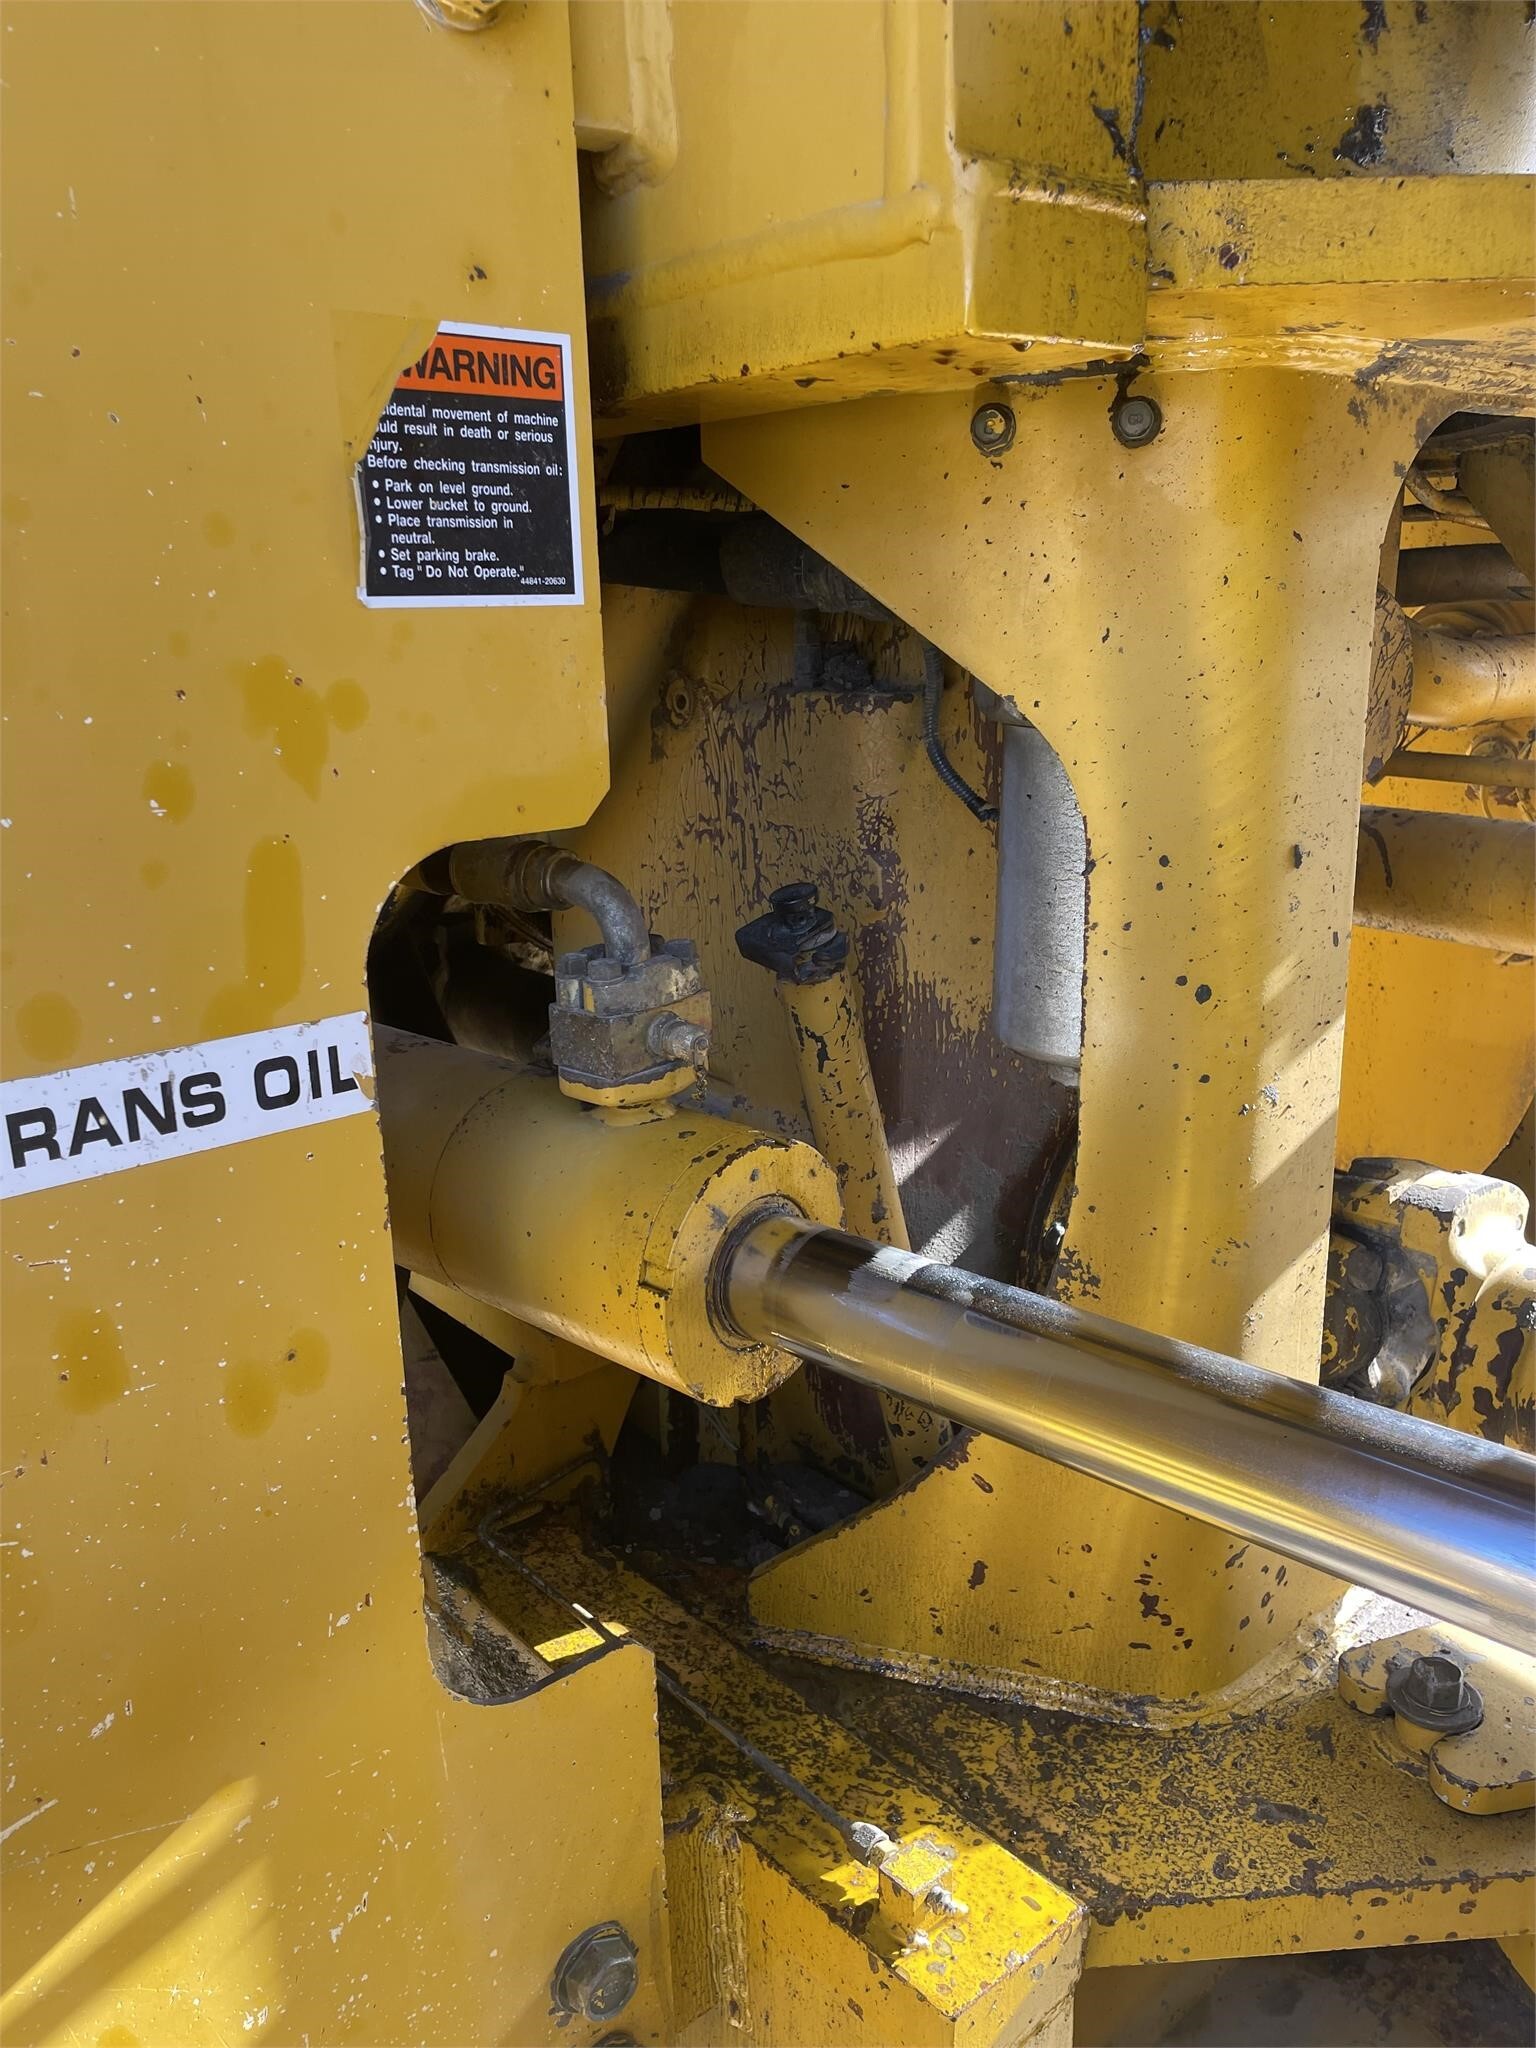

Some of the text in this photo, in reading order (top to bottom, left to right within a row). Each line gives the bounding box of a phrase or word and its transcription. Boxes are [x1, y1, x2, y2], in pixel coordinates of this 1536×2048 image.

[432, 408, 491, 423] movement
[497, 411, 508, 423] of
[514, 413, 559, 427] machine
[404, 422, 437, 436] result
[443, 424, 454, 437] in
[460, 425, 492, 439] death
[498, 430, 509, 440] or
[515, 430, 554, 443] serious
[367, 454, 563, 477] Before checking transmission oil:
[385, 478, 514, 497] Park on level ground.
[386, 496, 532, 515] Lower bucket to ground.
[388, 514, 514, 529] Place transmission in
[391, 531, 435, 545] neutral.
[390, 548, 500, 565] Set parking brake.
[392, 565, 415, 581] Tag
[448, 565, 469, 578] Not
[520, 576, 566, 586] 44841-20630
[253, 1045, 358, 1111] OIL
